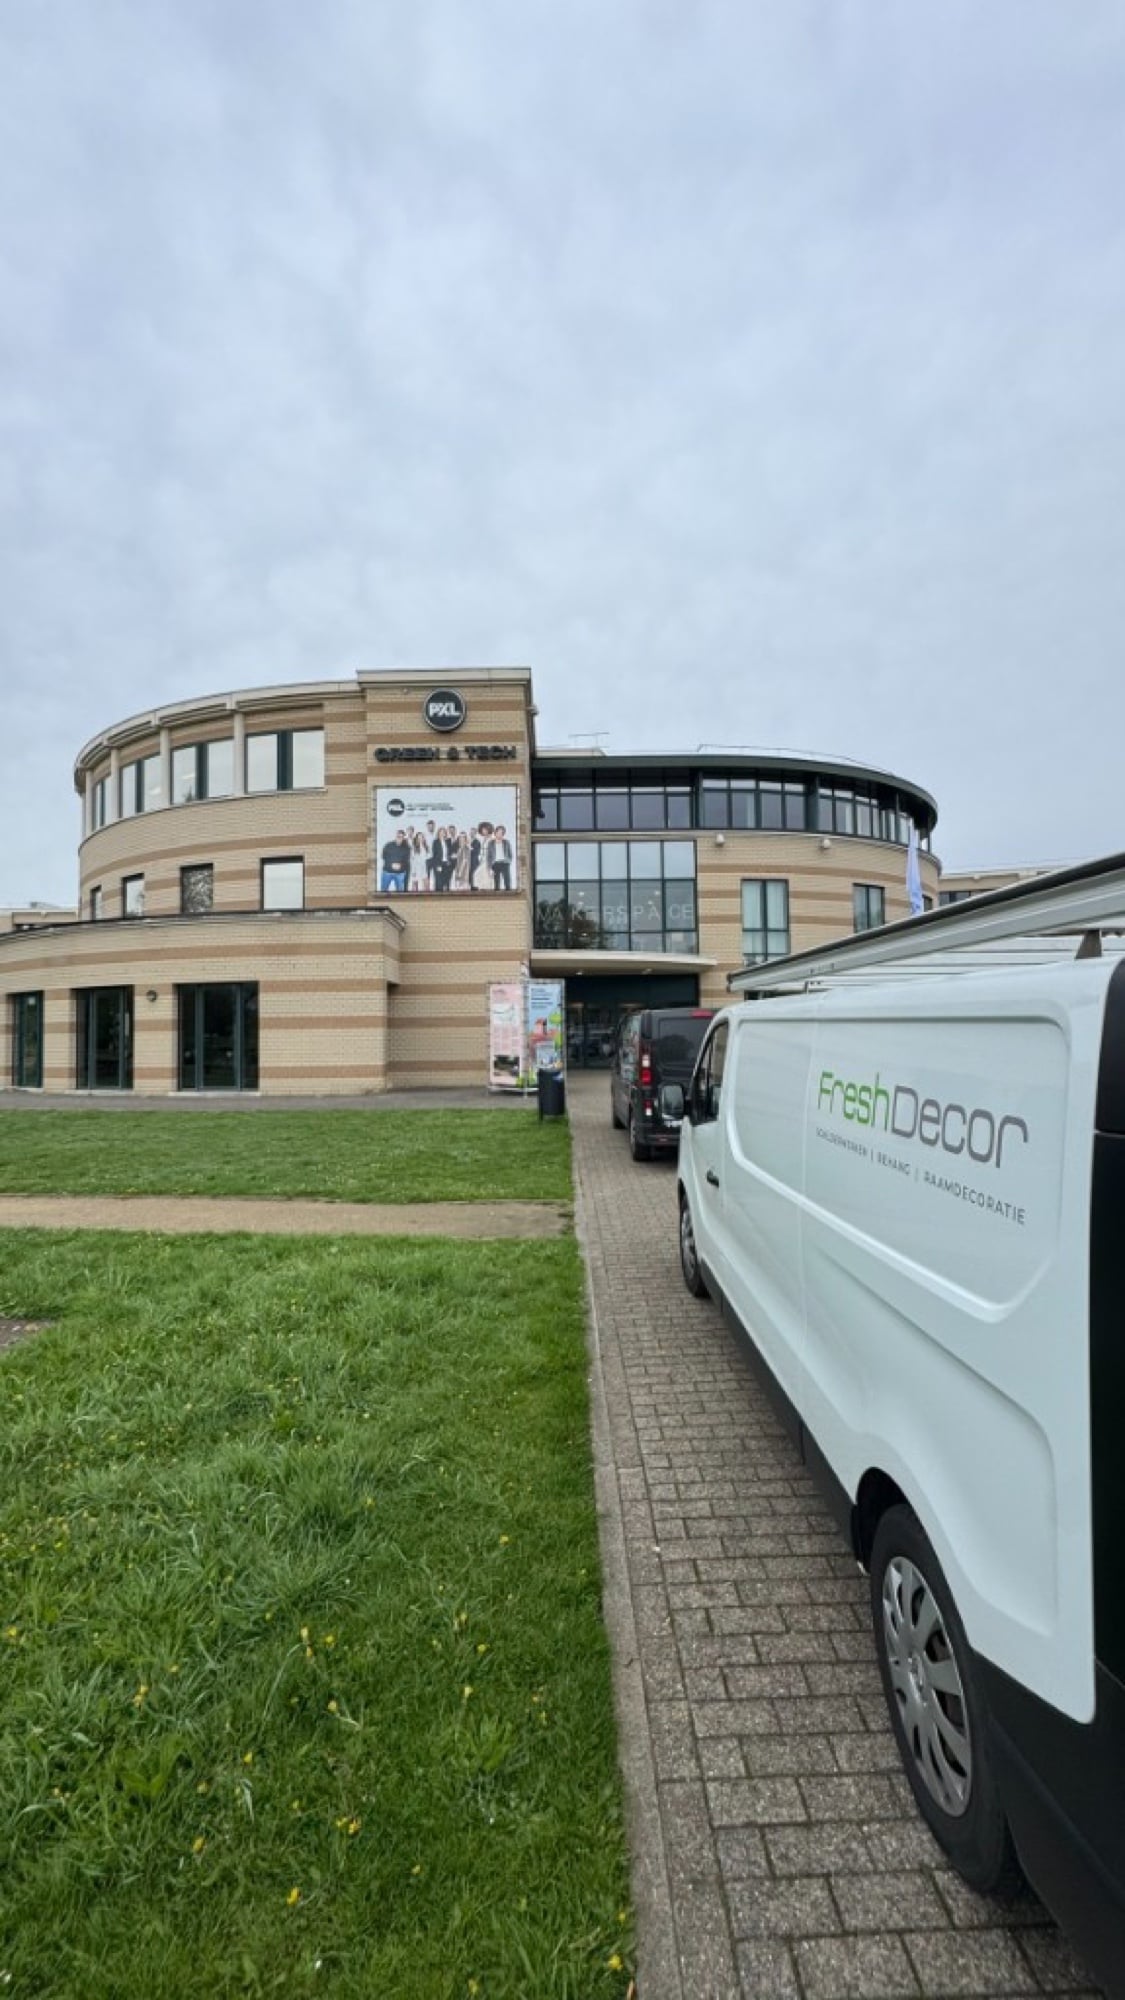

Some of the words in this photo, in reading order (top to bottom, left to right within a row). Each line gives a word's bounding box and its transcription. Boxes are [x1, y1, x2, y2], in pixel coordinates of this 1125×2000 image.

[428, 702, 461, 717] PXL
[374, 747, 440, 762] GREEN
[447, 746, 460, 761] &
[464, 745, 517, 761] TECH
[923, 1169, 1026, 1225] RAAMDECORATIE
